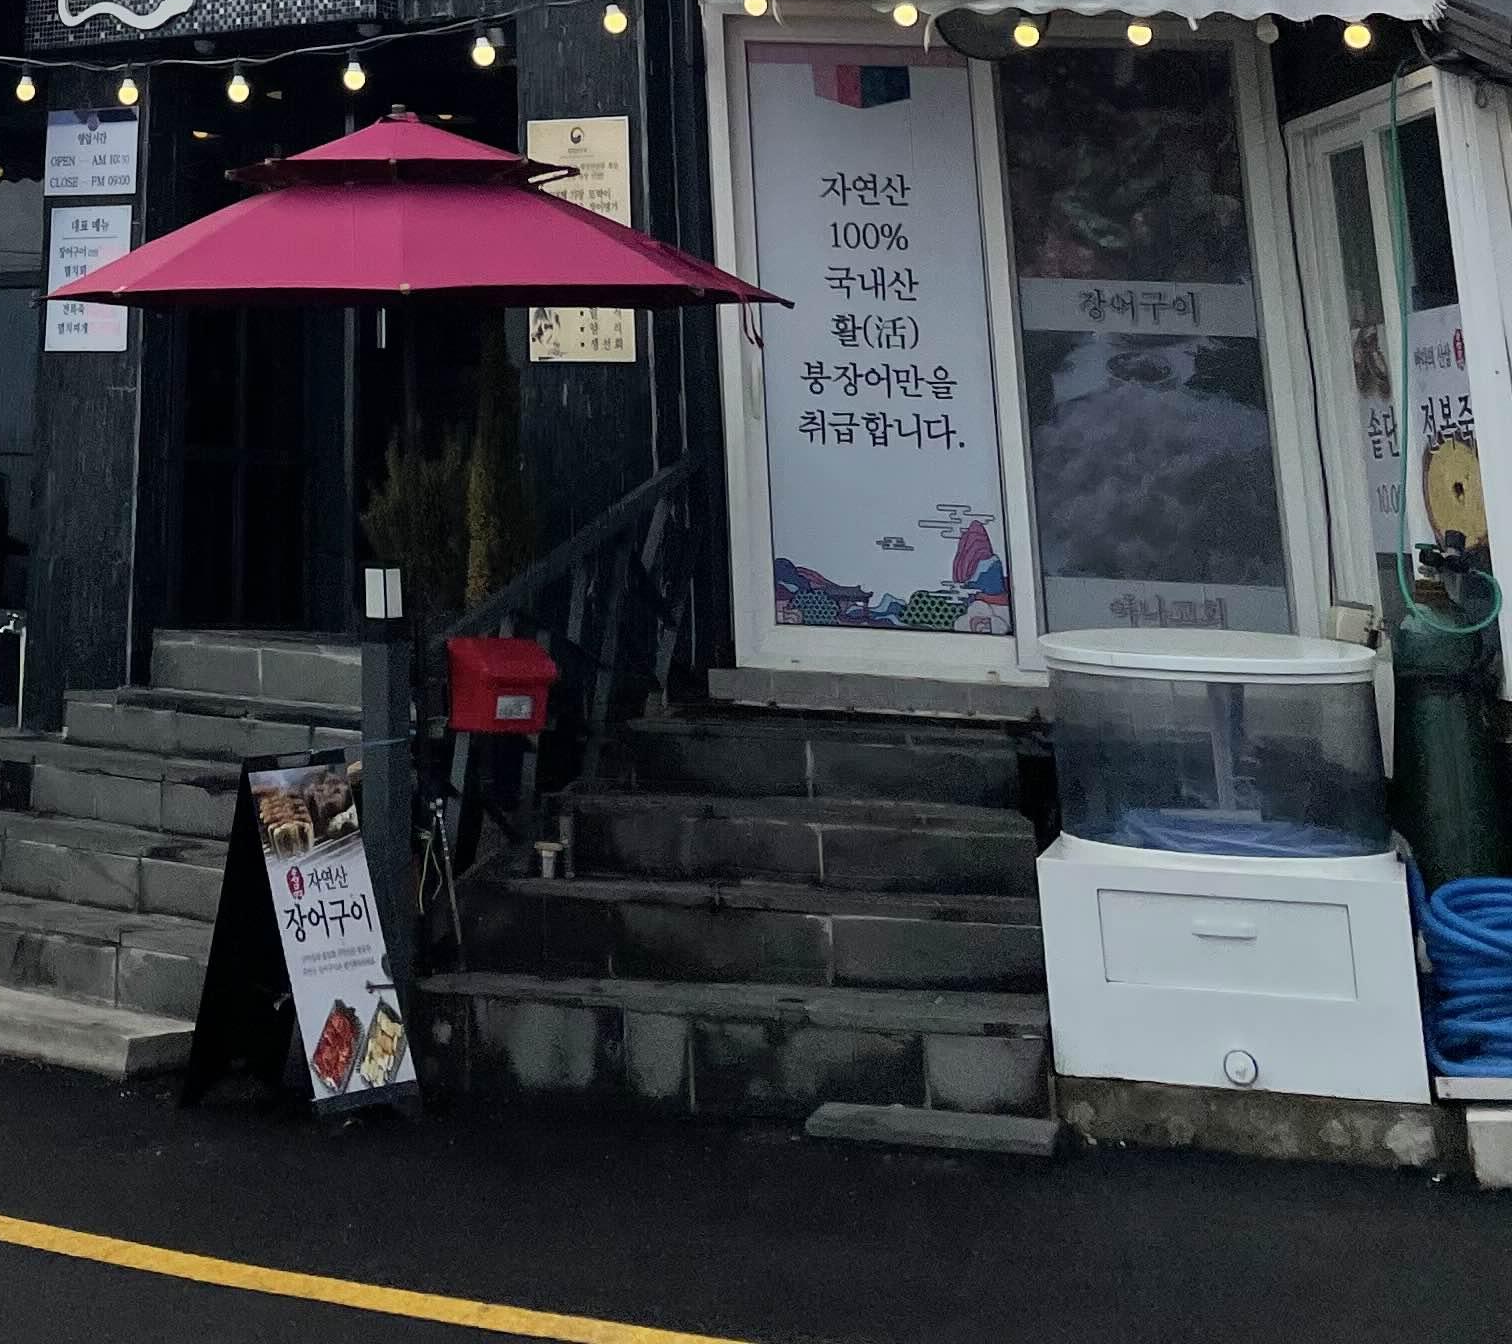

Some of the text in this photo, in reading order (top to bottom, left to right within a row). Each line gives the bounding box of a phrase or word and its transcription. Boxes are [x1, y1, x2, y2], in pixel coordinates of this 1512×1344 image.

[50, 155, 76, 167] OPEN
[92, 154, 107, 166] AM
[49, 176, 79, 188] CLOSE
[91, 175, 105, 187] PM
[819, 173, 911, 209] 자연산
[828, 220, 910, 252] 100%
[824, 266, 919, 303] 국내산
[1080, 288, 1199, 326] 장어구이
[829, 315, 920, 353] 활(活)
[800, 361, 958, 402] 붕장어만을
[798, 410, 967, 452] 취급합니다.
[1367, 406, 1401, 459] 솥단
[307, 863, 349, 893] 자연산
[284, 894, 373, 943] 장어구이
